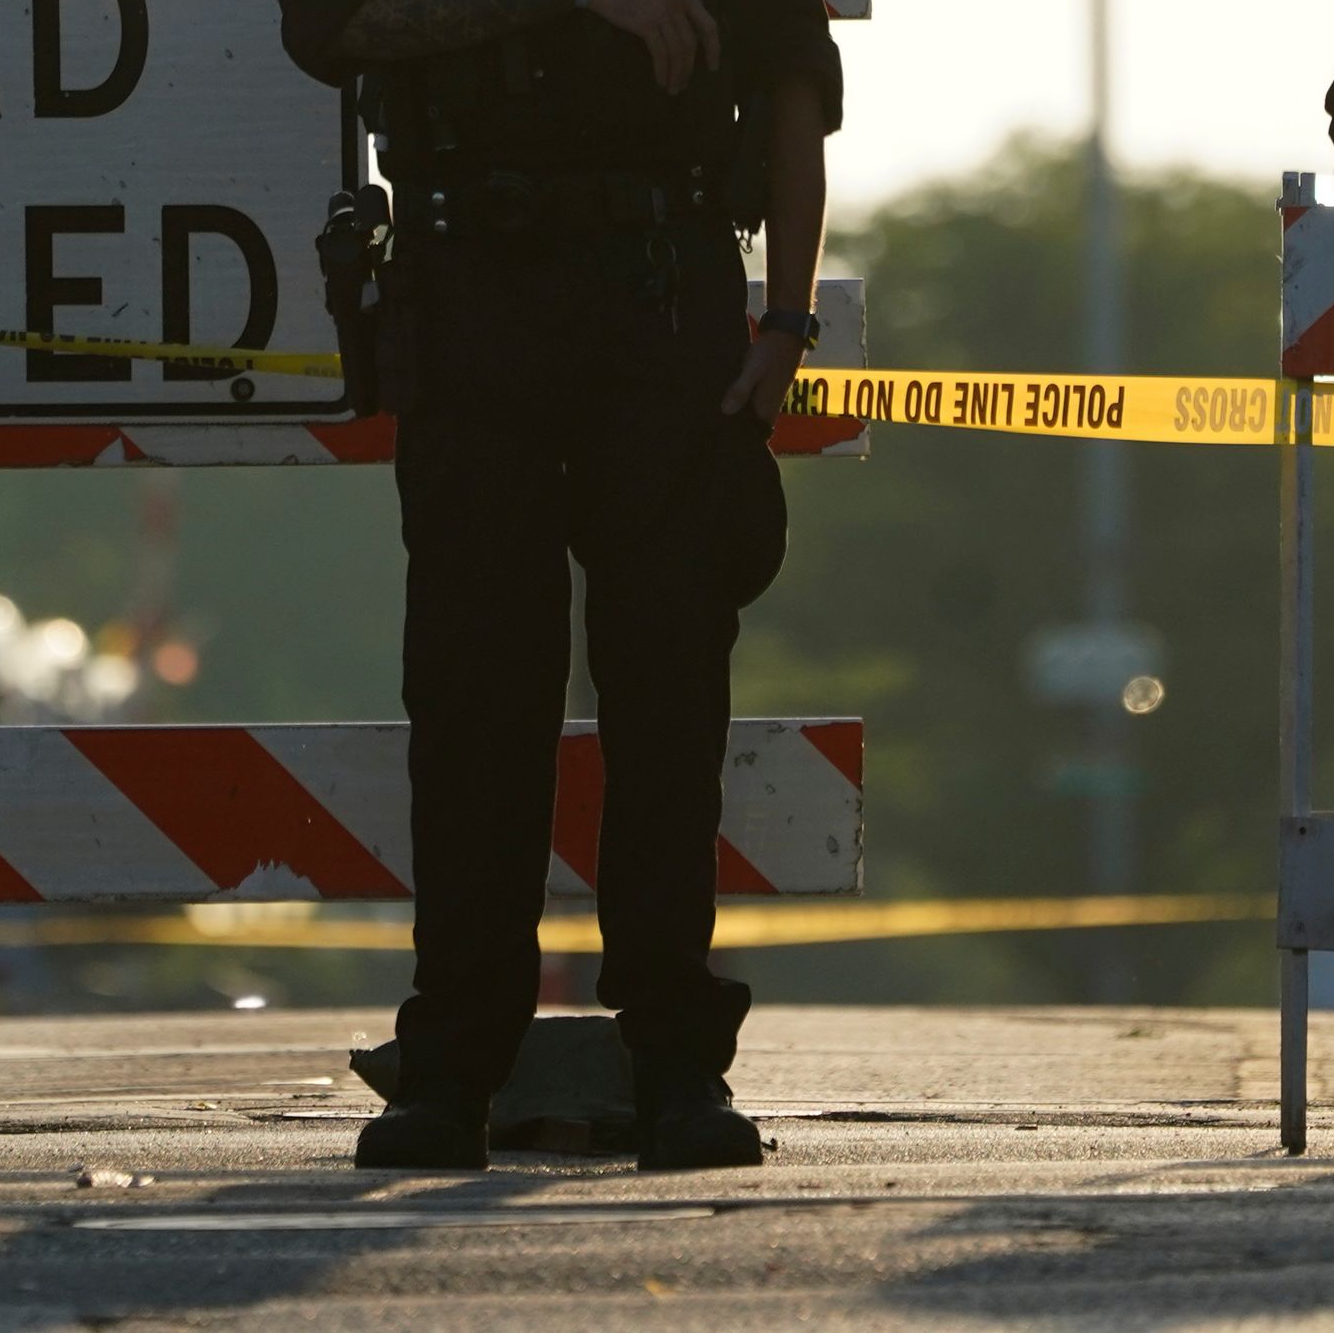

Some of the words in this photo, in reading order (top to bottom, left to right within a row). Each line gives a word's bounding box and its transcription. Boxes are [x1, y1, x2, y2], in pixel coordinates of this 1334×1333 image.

[781, 377, 829, 418] CR
[838, 378, 895, 421] NOT
[905, 380, 943, 423] DO
[953, 382, 1015, 426] LINE
[1024, 384, 1125, 429] POLICE
[1174, 386, 1267, 433] CROSS
[1277, 388, 1333, 435] NOT
